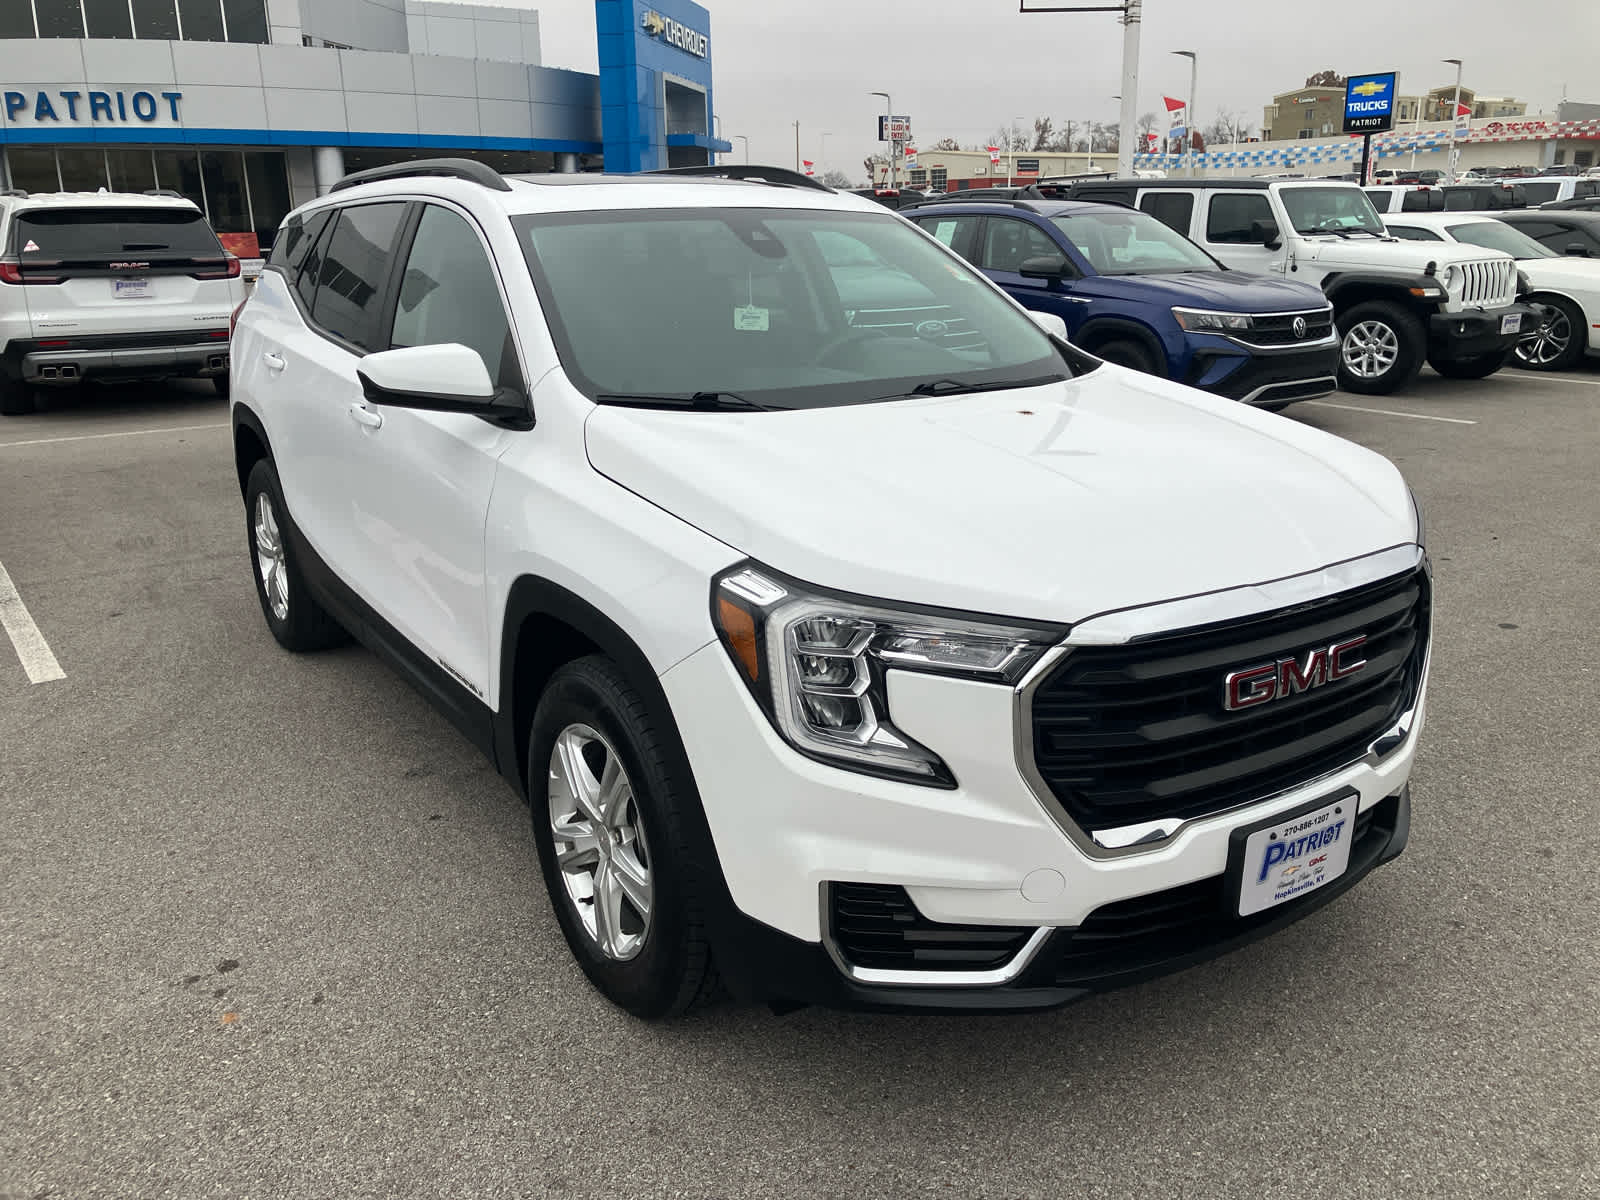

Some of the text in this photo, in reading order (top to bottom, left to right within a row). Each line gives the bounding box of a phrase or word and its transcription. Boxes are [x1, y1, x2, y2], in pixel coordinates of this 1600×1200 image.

[665, 16, 709, 58] CHEVROLET
[4, 91, 183, 122] PATRIOT
[1347, 99, 1389, 112] TRUCKS
[1351, 118, 1382, 127] PATRIOT
[1224, 634, 1367, 711] GMC
[1283, 812, 1330, 836] 270-886-1207
[1257, 819, 1346, 883] PATRIOT
[1308, 853, 1328, 867] GMC
[1274, 880, 1315, 900] Hopkinsville,
[1316, 874, 1325, 883] KY
